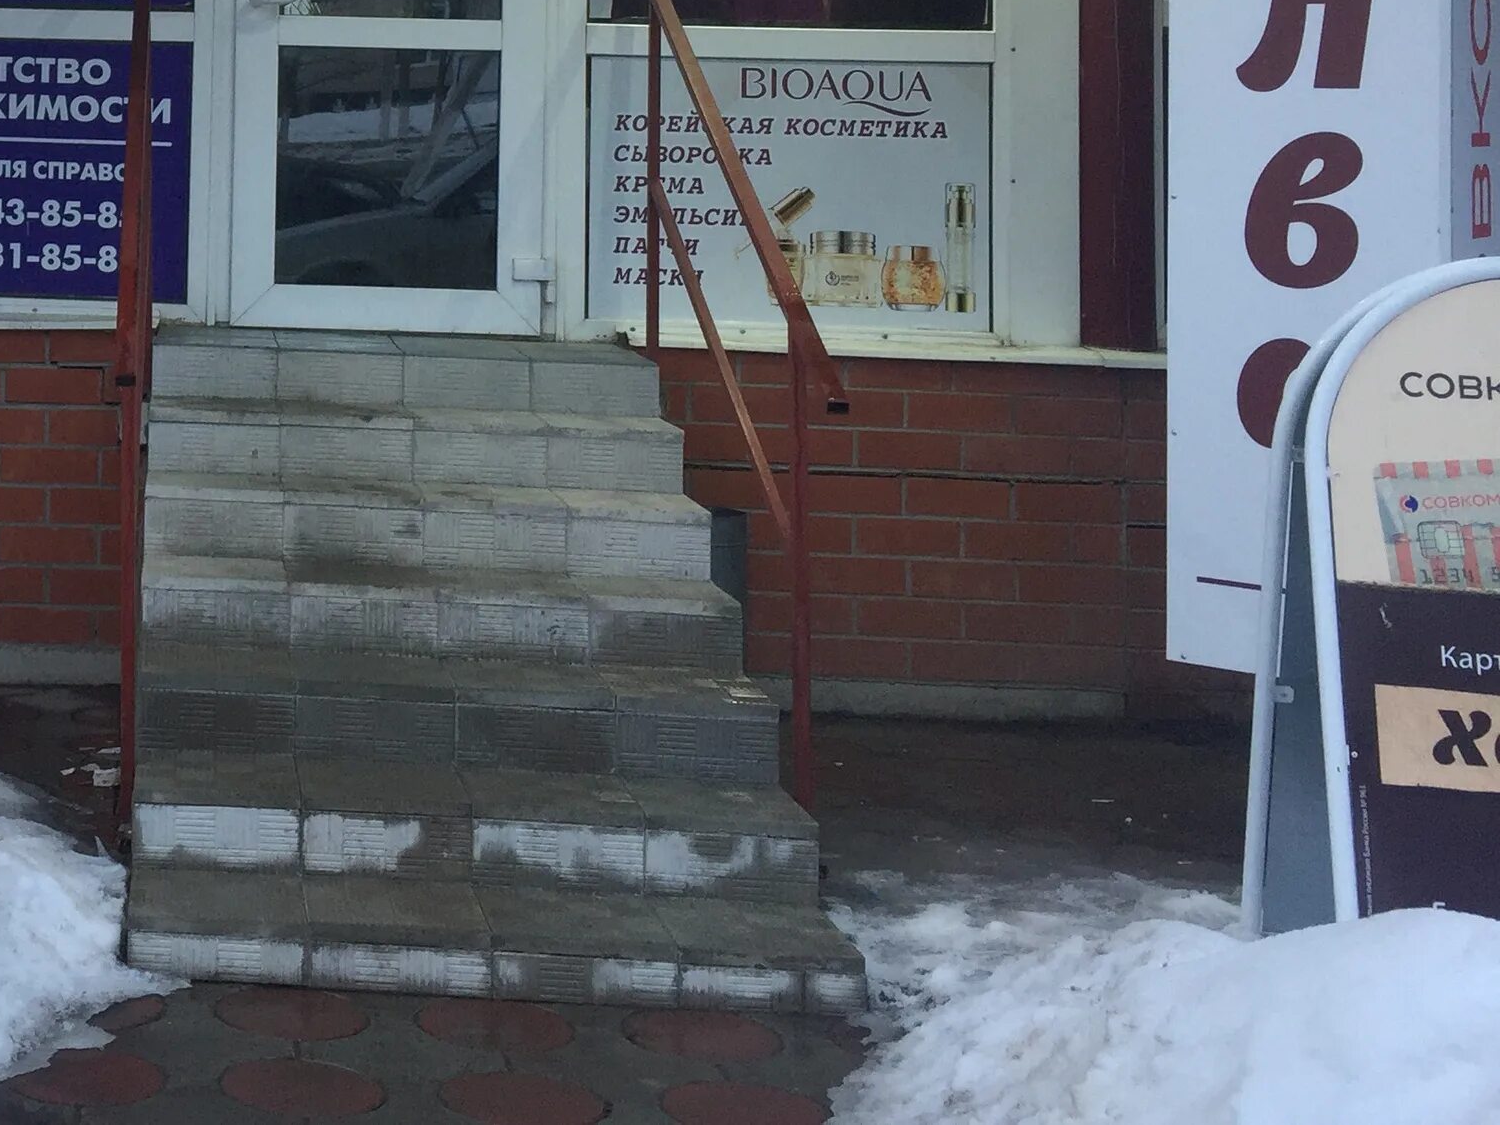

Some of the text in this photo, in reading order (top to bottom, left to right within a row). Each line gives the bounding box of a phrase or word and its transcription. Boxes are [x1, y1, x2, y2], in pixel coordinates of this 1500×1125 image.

[740, 66, 933, 115] BIOAQUA
[614, 109, 949, 139] КОЕЙКАЯ КОСМЕТИКА
[33, 161, 126, 183] СПРАВО
[613, 206, 751, 226] ЭМЛЬСИ
[1432, 708, 1500, 767] Х
